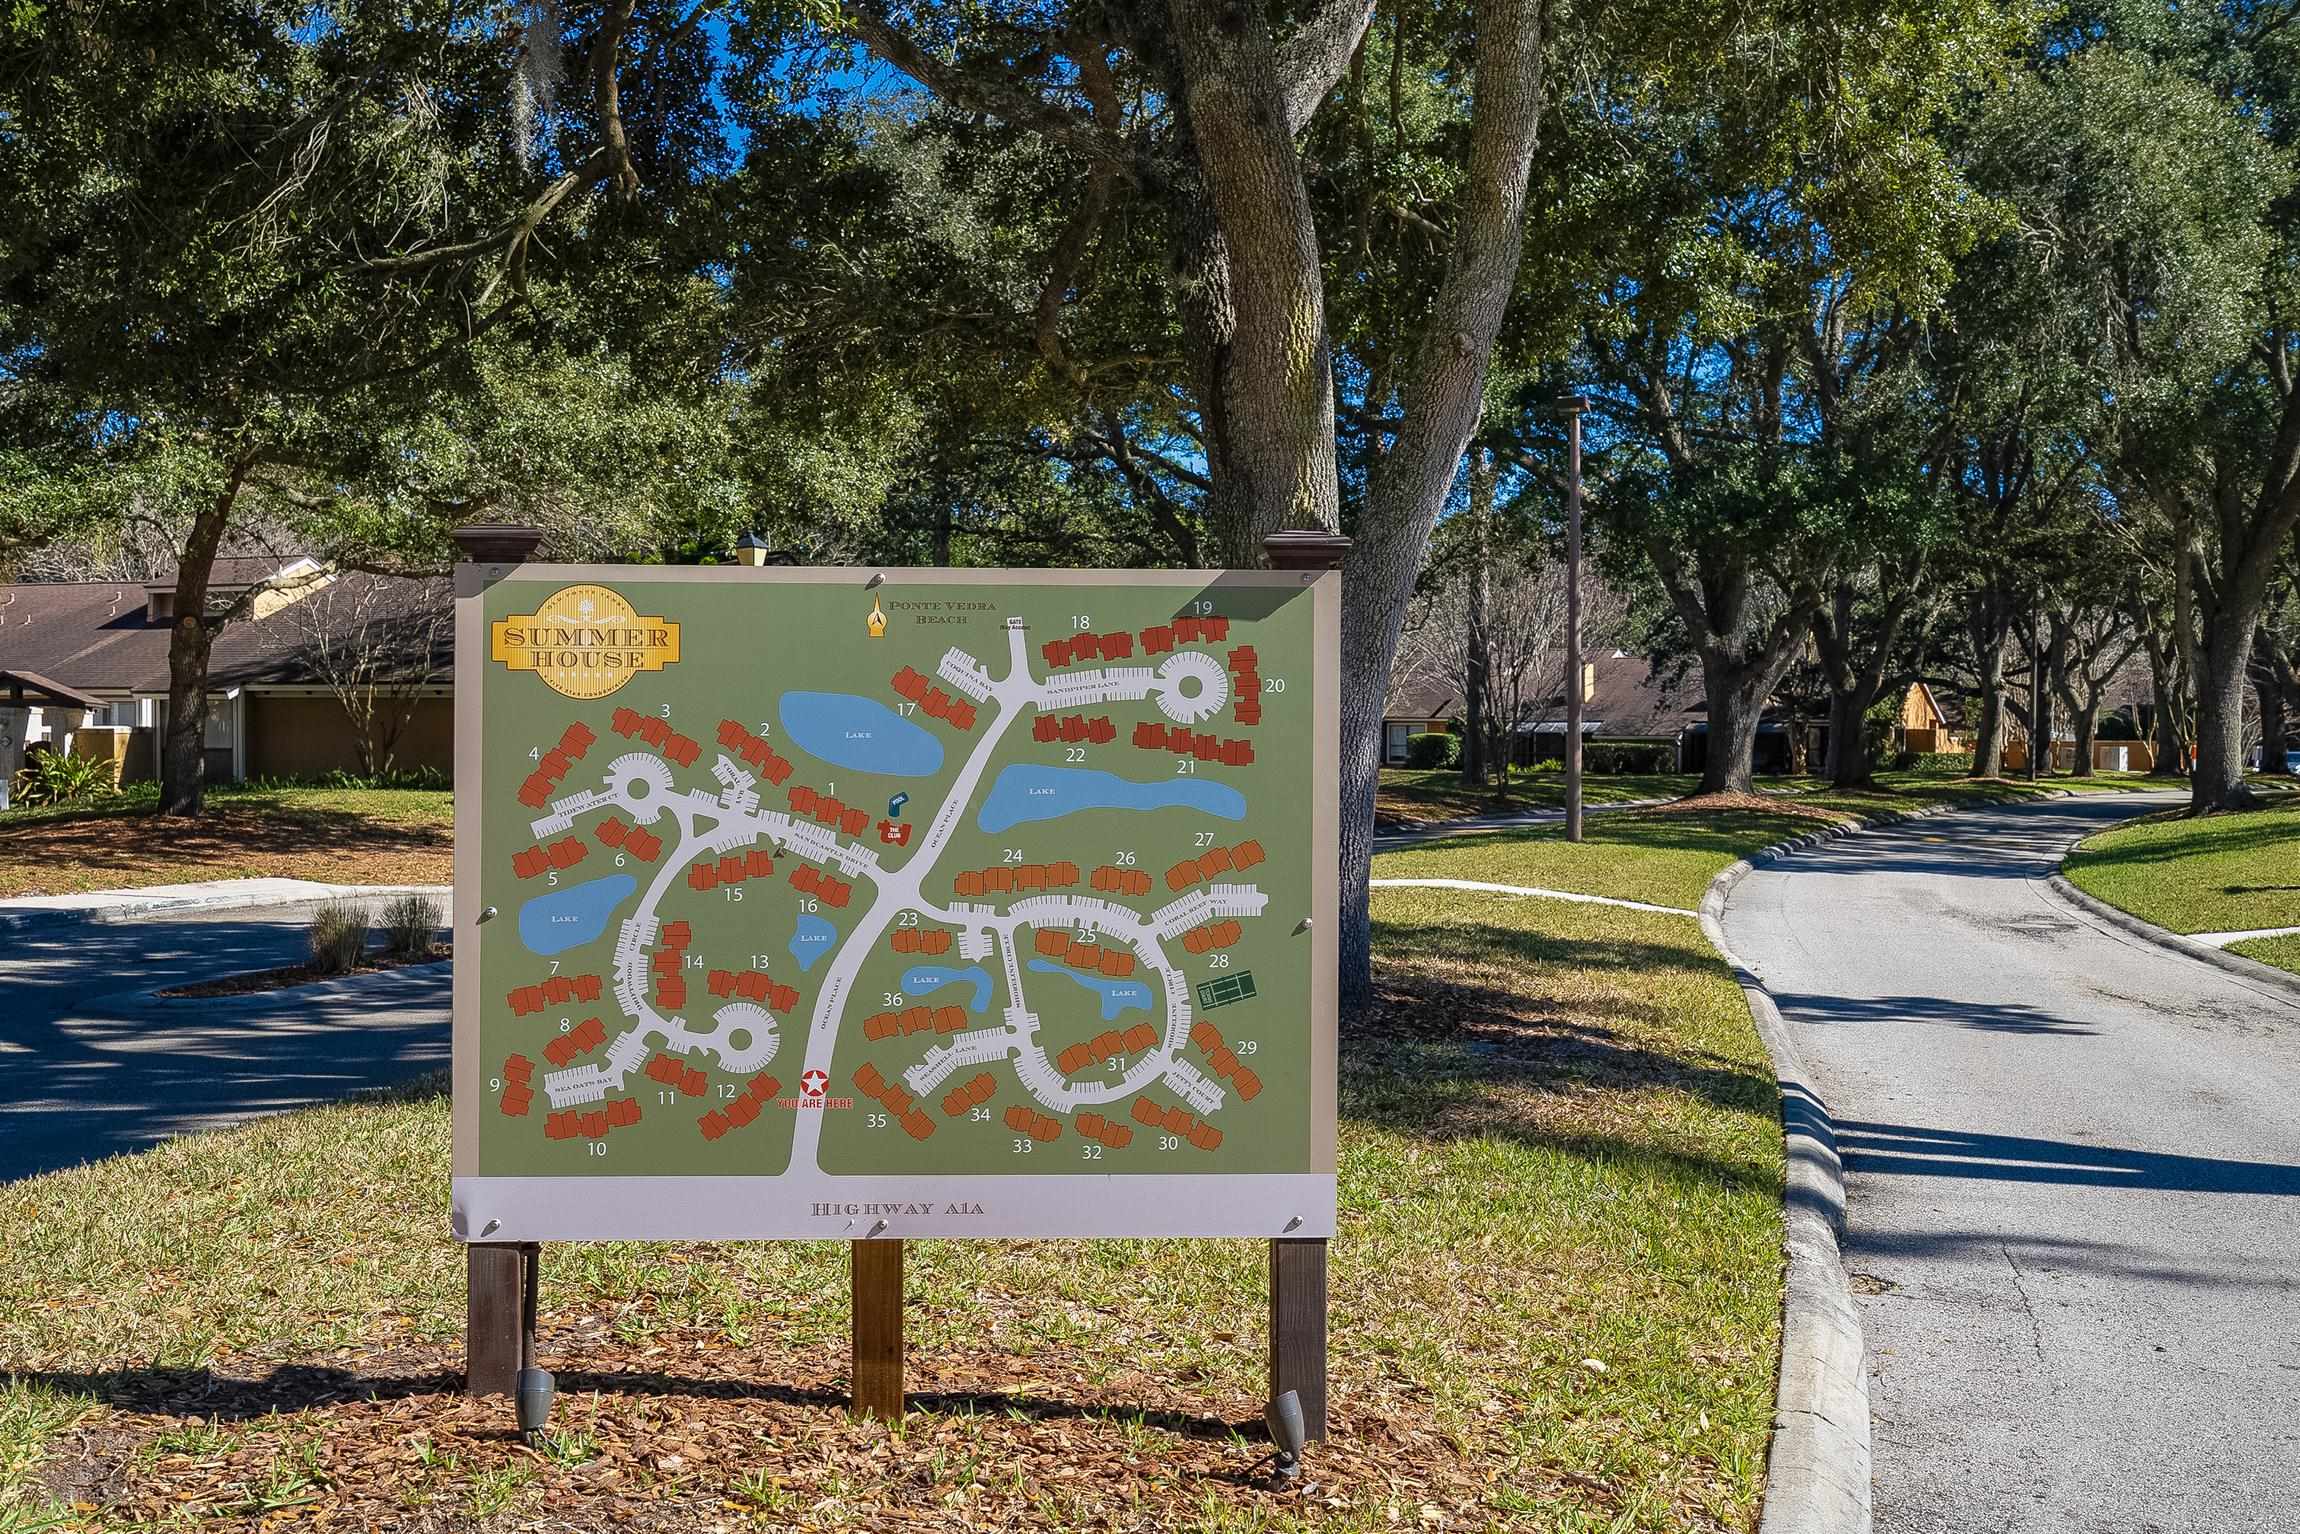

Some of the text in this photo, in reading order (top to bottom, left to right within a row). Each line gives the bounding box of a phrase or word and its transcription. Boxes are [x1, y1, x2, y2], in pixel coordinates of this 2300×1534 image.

[888, 601, 998, 611] PONTE VEDRA
[1194, 601, 1213, 615] 19
[915, 615, 968, 625] BEACH
[1071, 616, 1090, 630] 18
[504, 627, 669, 647] SUMMER
[532, 651, 644, 668] HOUSE
[946, 660, 993, 692] COQUINA BAY
[1047, 680, 1120, 695] SANDPIPER LANE
[1265, 679, 1285, 693] 20
[661, 703, 671, 718] 3
[897, 702, 916, 716] 17
[760, 722, 770, 737] 2
[845, 731, 872, 739] LAKE
[528, 746, 540, 760] 4
[1065, 748, 1085, 763] 22
[723, 763, 741, 785] CORAL
[1177, 760, 1195, 774] 21
[828, 782, 835, 795] 1
[557, 792, 620, 817] TIDEWATER CT
[931, 799, 959, 848] OCEAN PLACE
[1194, 832, 1214, 847] 27
[615, 853, 625, 867] 6
[1002, 849, 1024, 863] 24
[1115, 851, 1136, 865] 26
[548, 871, 558, 886] 5
[724, 887, 743, 902] 15
[799, 899, 818, 913] 16
[551, 915, 579, 923] LAKE
[898, 912, 919, 926] 23
[1164, 910, 1189, 926] CORAL
[1189, 901, 1208, 913] REEF
[629, 922, 641, 952] CIRCLE
[1076, 929, 1097, 943] 25
[549, 961, 560, 975] 7
[685, 955, 705, 969] 14
[750, 955, 769, 969] 13
[1208, 954, 1229, 968] 28
[1003, 934, 1021, 1009] SHORELINE CIRCLE
[912, 976, 940, 984] LAKE
[820, 976, 842, 1030] OCEAN PLACE
[882, 992, 903, 1007] 36
[1165, 967, 1177, 1048] SHORELINE CIRCLE
[559, 1017, 570, 1032] 8
[1237, 1041, 1257, 1055] 29
[920, 1045, 977, 1081] SEASHELL LANE
[1107, 1058, 1126, 1071] 31
[489, 1078, 501, 1092] 9
[555, 1084, 571, 1093] SEA
[596, 1076, 614, 1085] BAY
[716, 1084, 736, 1098] 12
[657, 1091, 675, 1105] 11
[1192, 1086, 1215, 1104] COURT
[777, 1098, 853, 1109] YOU ARE HERE
[866, 1113, 887, 1128] 35
[970, 1108, 991, 1122] 34
[587, 1142, 607, 1156] 10
[1012, 1139, 1032, 1153] 33
[1159, 1136, 1178, 1150] 30
[1082, 1146, 1102, 1160] 32
[810, 1202, 985, 1216] HIGHWAY A1A
